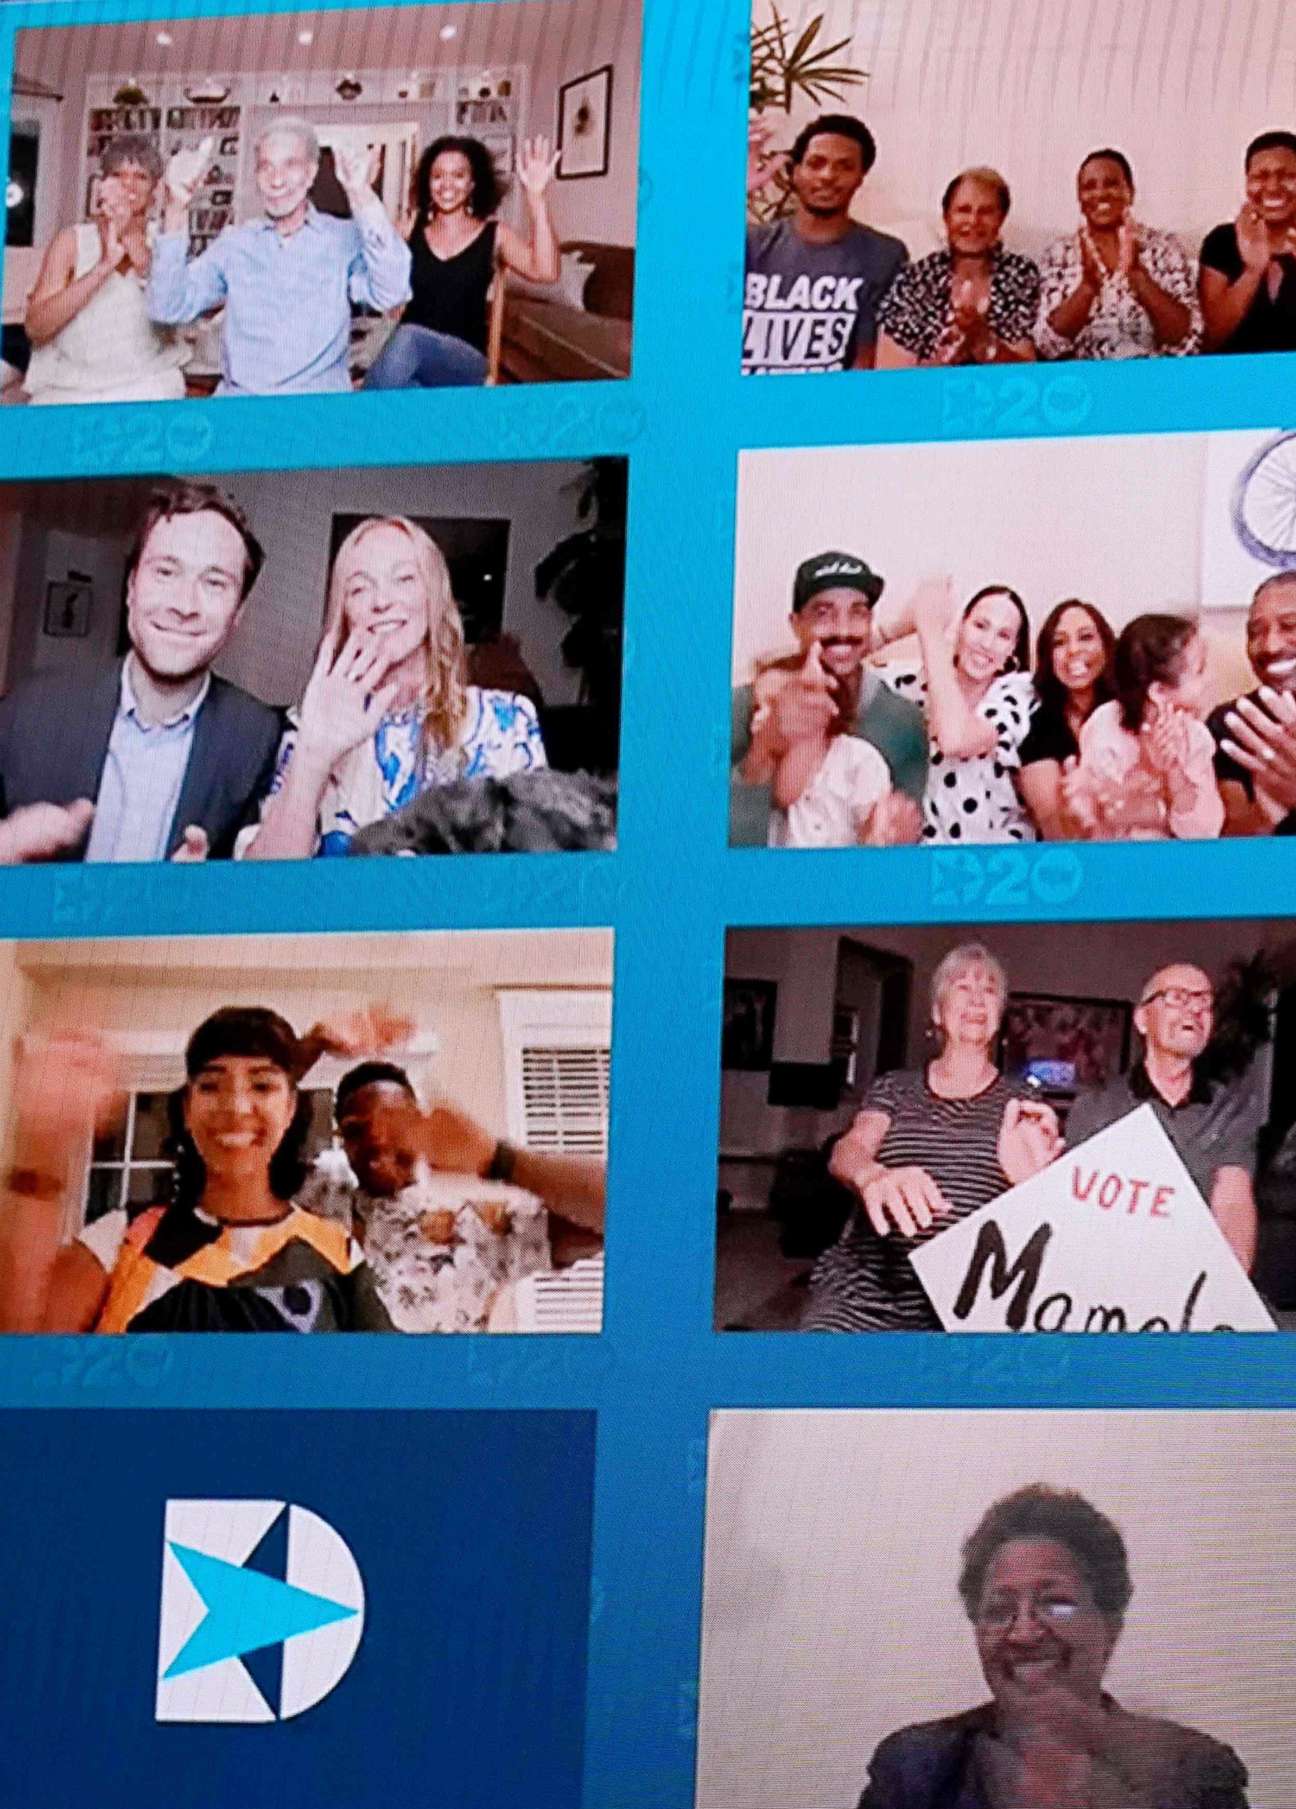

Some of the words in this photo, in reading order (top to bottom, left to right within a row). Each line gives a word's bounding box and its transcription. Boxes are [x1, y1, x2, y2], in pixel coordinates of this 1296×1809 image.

[745, 273, 864, 310] BLACK
[742, 317, 848, 361] LIVES
[1071, 1165, 1177, 1217] VOTE
